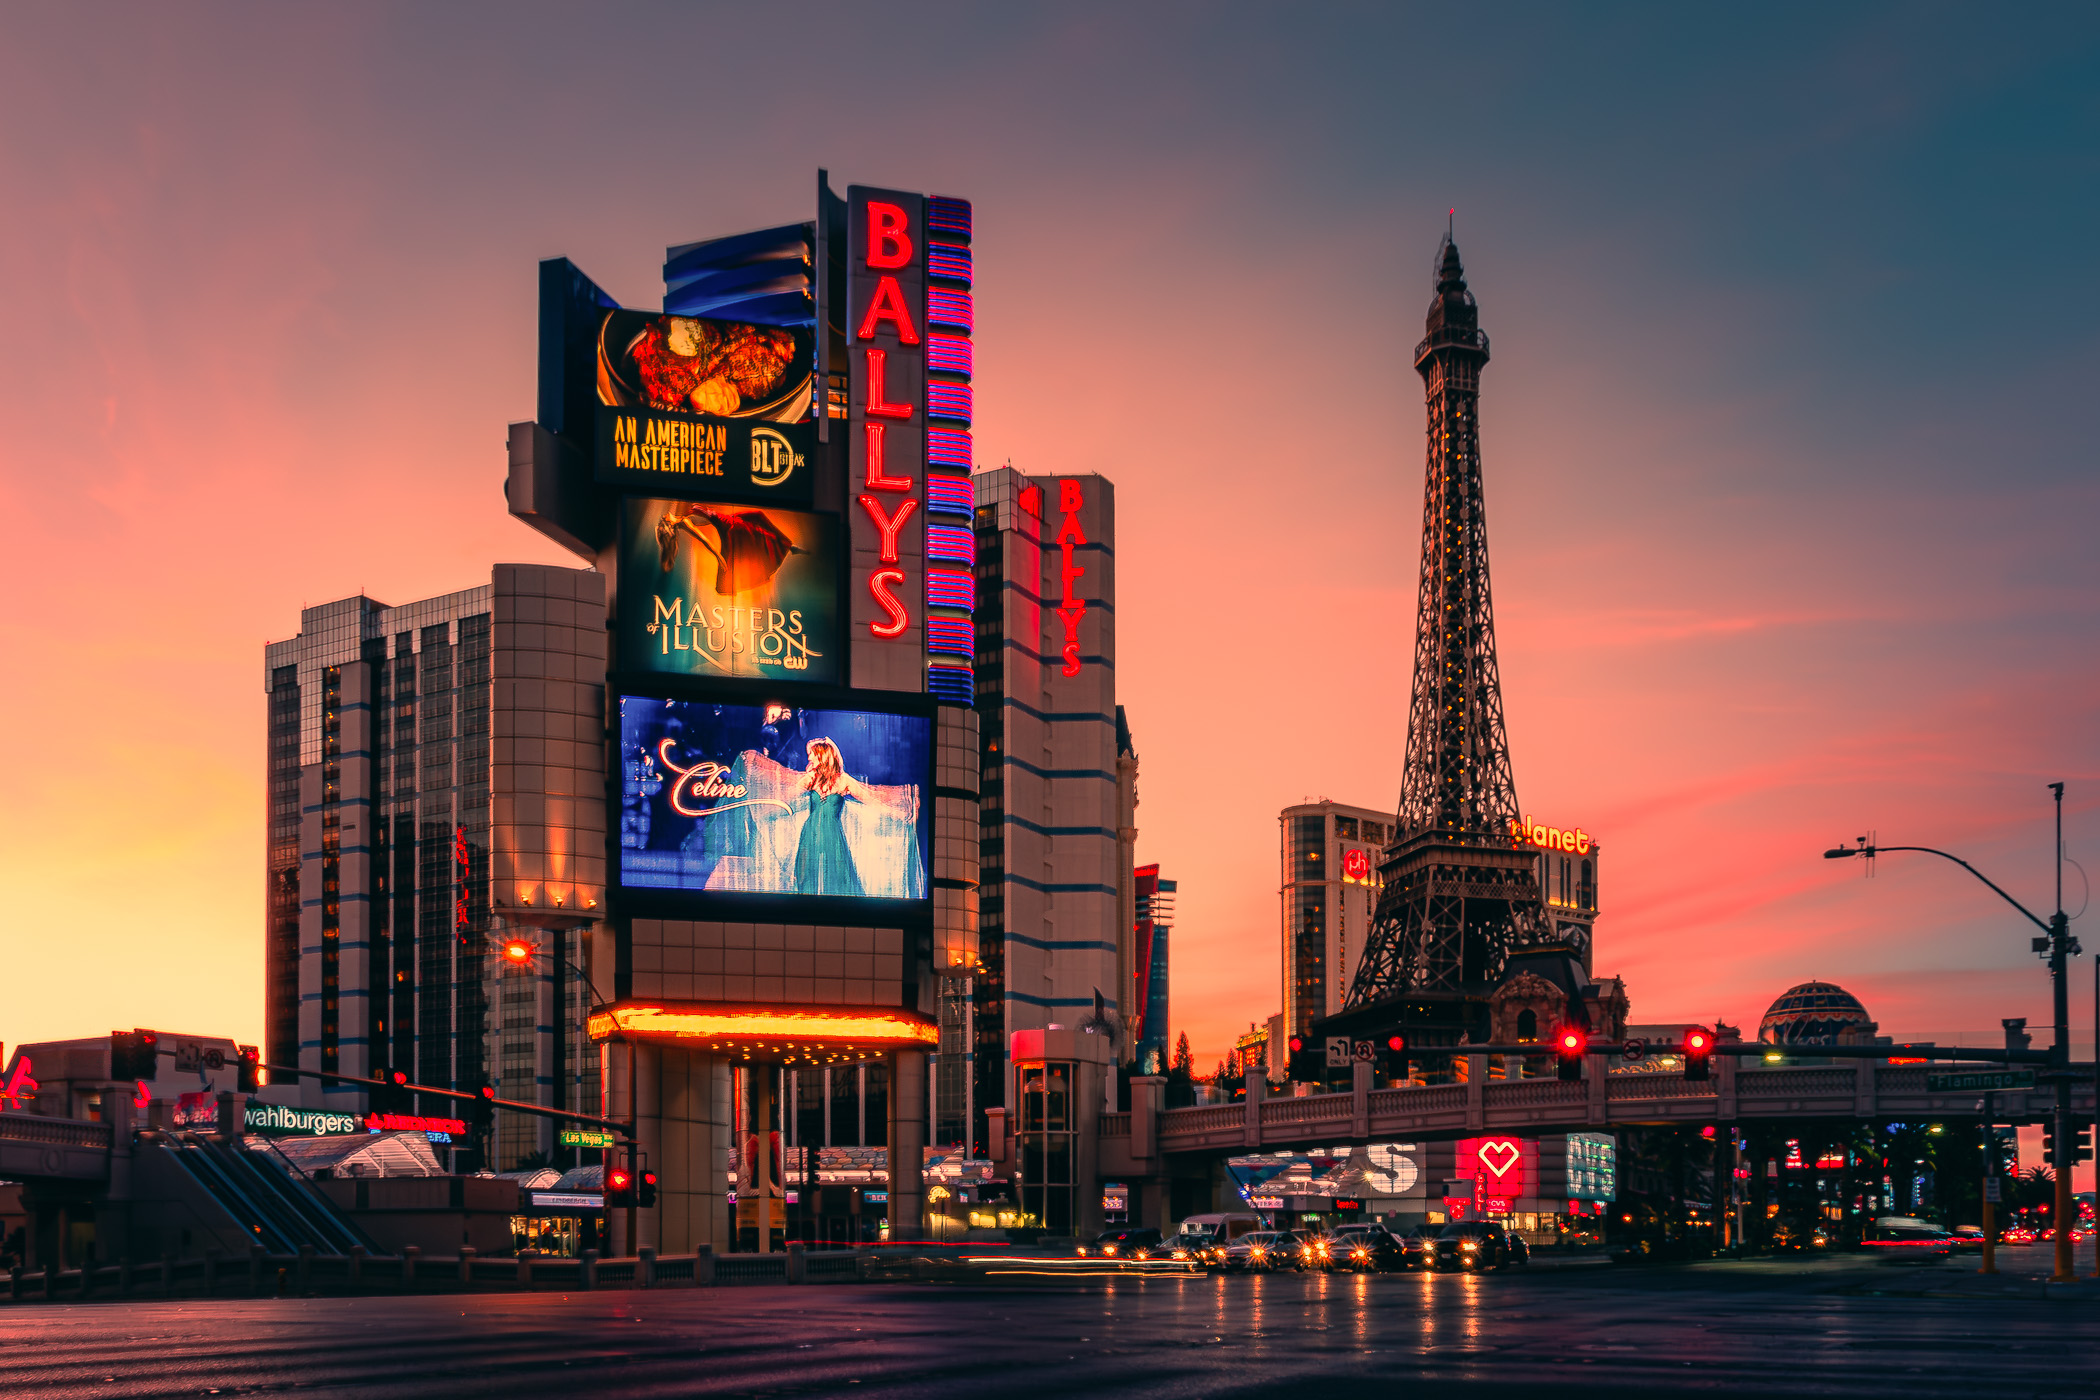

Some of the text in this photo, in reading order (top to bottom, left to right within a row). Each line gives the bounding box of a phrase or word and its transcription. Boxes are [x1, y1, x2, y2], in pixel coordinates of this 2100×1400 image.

[615, 415, 727, 451] AN AMERICAN
[858, 201, 919, 638] BALLYS
[615, 441, 725, 476] MASTERPIECE
[751, 438, 783, 474] BLT
[1056, 479, 1088, 677] BALLYS
[653, 594, 806, 638] MASTERS
[661, 622, 808, 660] ILLUSION
[1937, 1075, 2013, 1089] Flamingo
[244, 1105, 354, 1135] wahlburgers
[580, 1133, 603, 1147] Vegas
